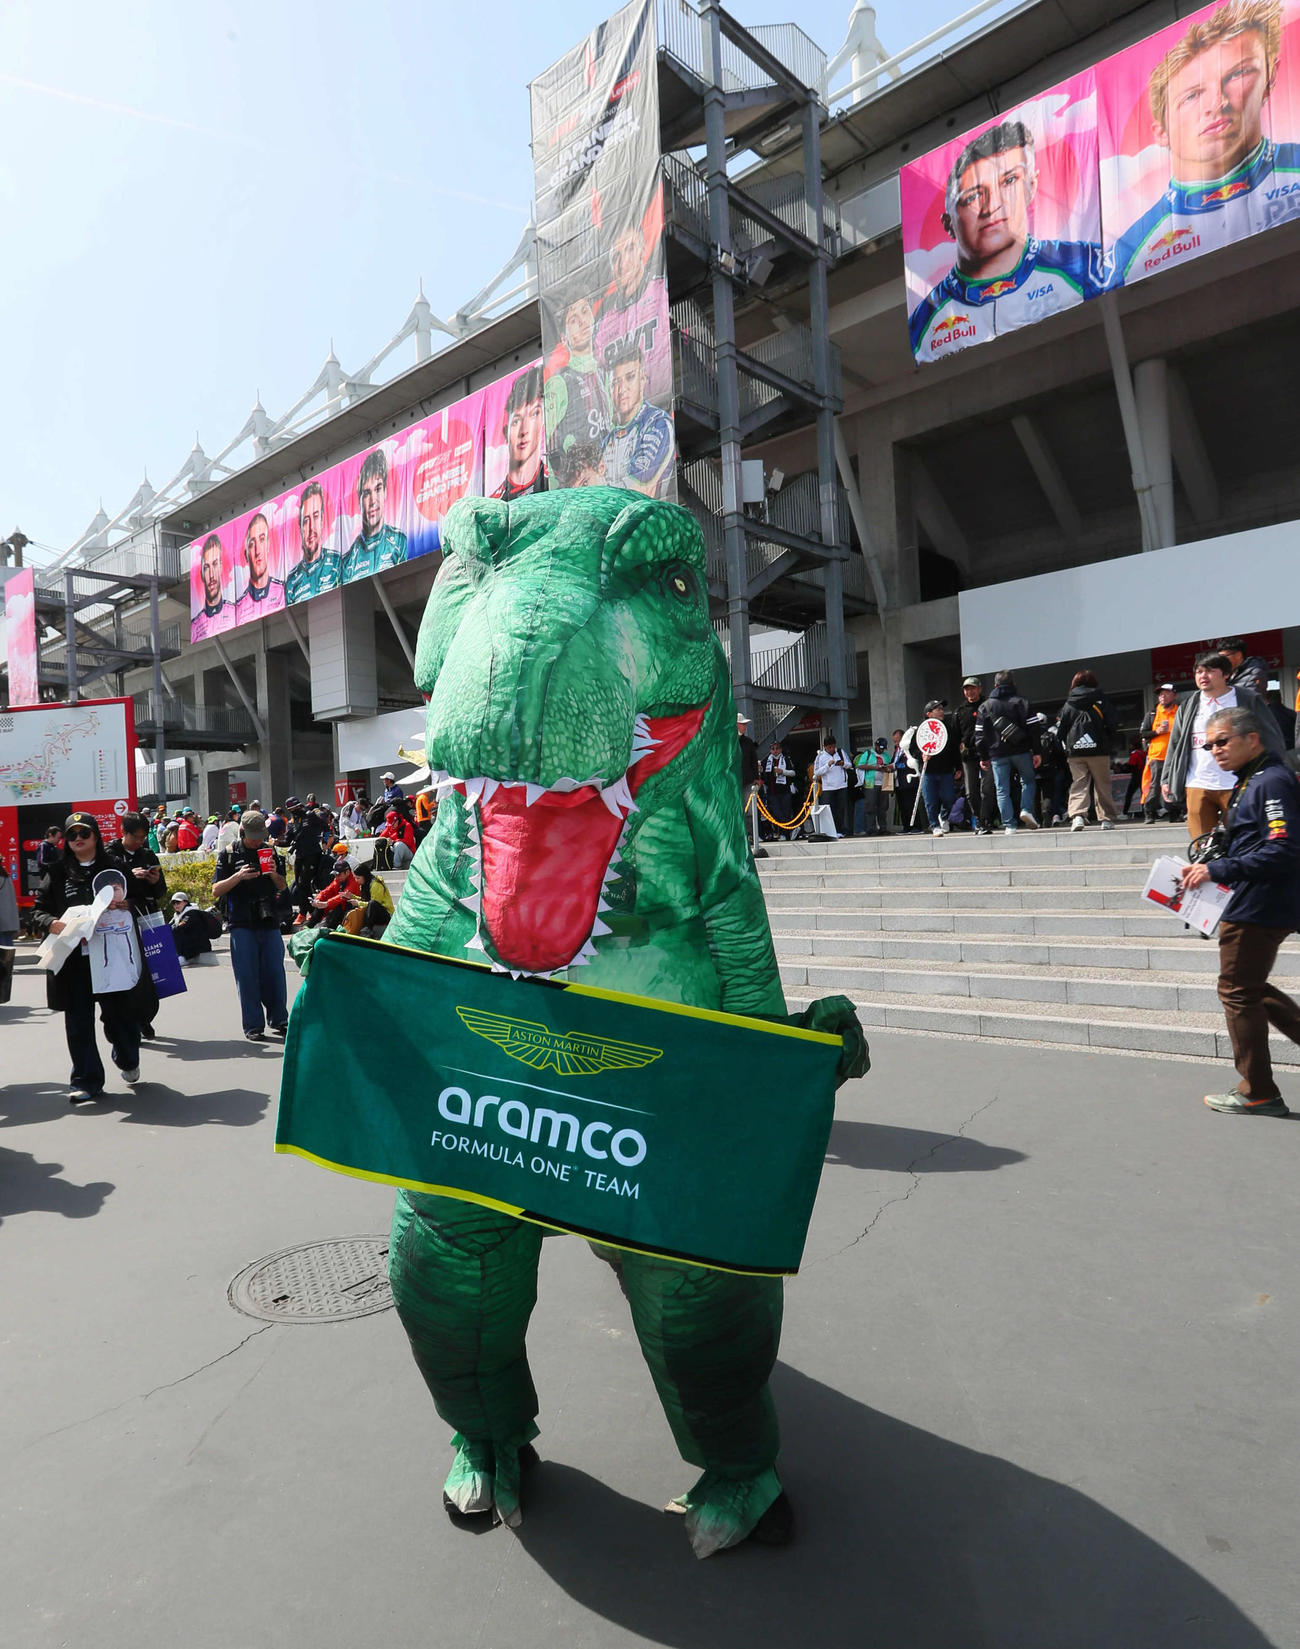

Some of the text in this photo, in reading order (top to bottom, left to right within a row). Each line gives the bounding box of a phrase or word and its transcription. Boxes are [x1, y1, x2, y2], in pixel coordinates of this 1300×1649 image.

[550, 145, 602, 186] GRAND
[602, 118, 640, 152] PRIX
[558, 107, 633, 167] JAPANESE
[1264, 182, 1300, 200] VISA
[1144, 235, 1201, 271] Red Bull
[1026, 284, 1053, 300] VISA
[930, 325, 976, 350] Red Bull
[416, 483, 447, 504] GRAND
[447, 471, 469, 490] PRIX
[421, 462, 466, 492] JAPANESE
[1073, 742, 1097, 750] adidas
[511, 1029, 600, 1057] ASTON MARTIN
[437, 1086, 648, 1167] aramco
[430, 1131, 641, 1200] FORMULA ONE TEAM
